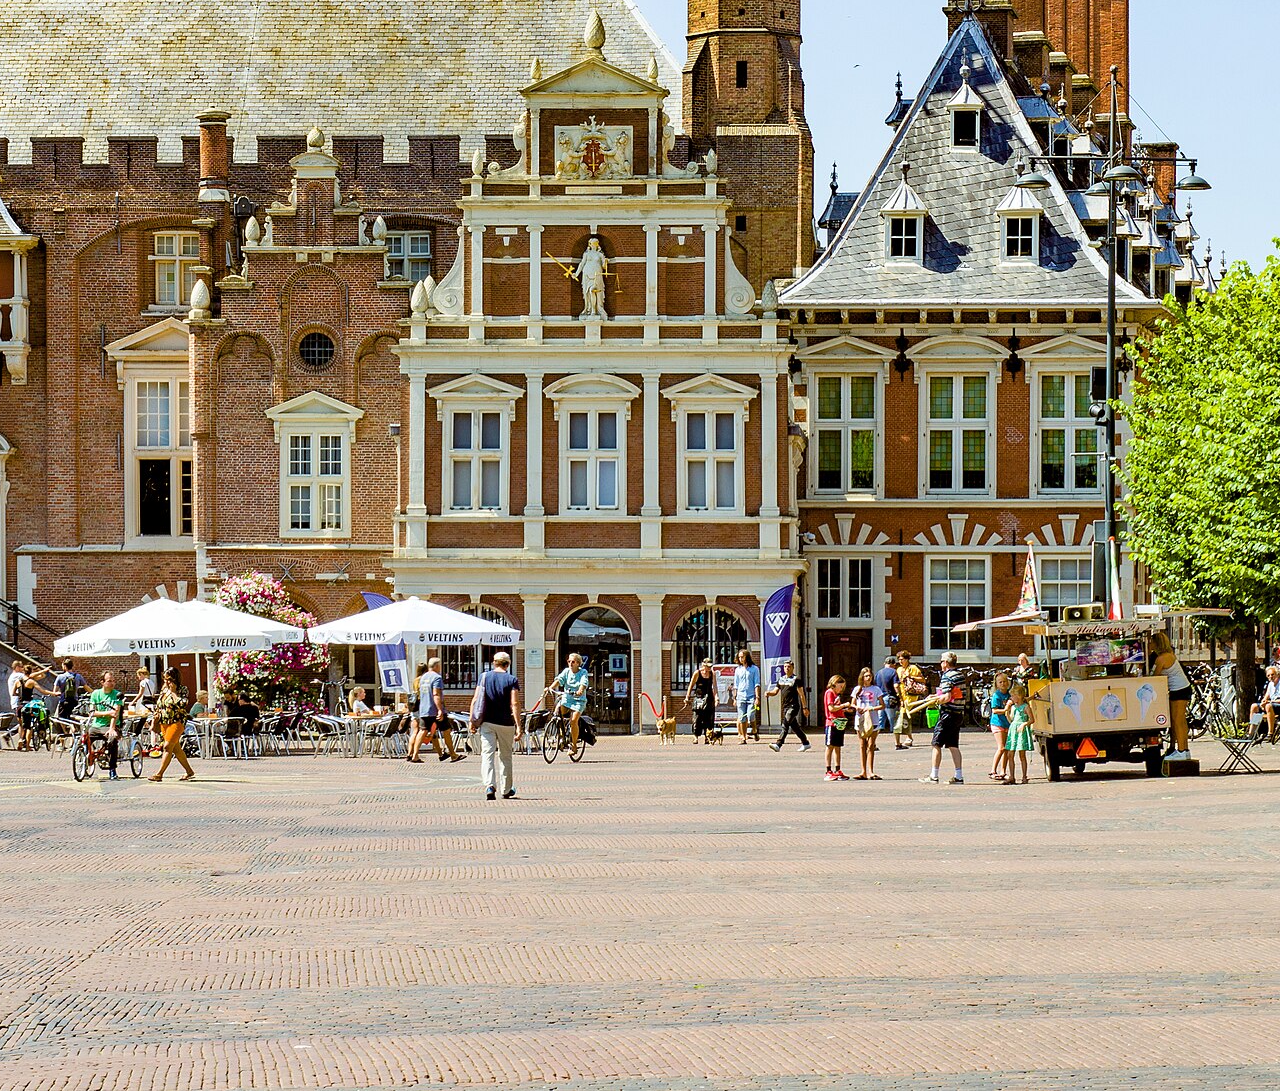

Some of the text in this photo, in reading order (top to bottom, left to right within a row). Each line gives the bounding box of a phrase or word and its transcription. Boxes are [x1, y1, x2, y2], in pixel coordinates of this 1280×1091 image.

[216, 637, 247, 647] VELTINS
[354, 632, 386, 642] VELTINS
[428, 633, 463, 643] VELTINS
[72, 642, 96, 652] VELTINS
[137, 639, 176, 649] VELTINS
